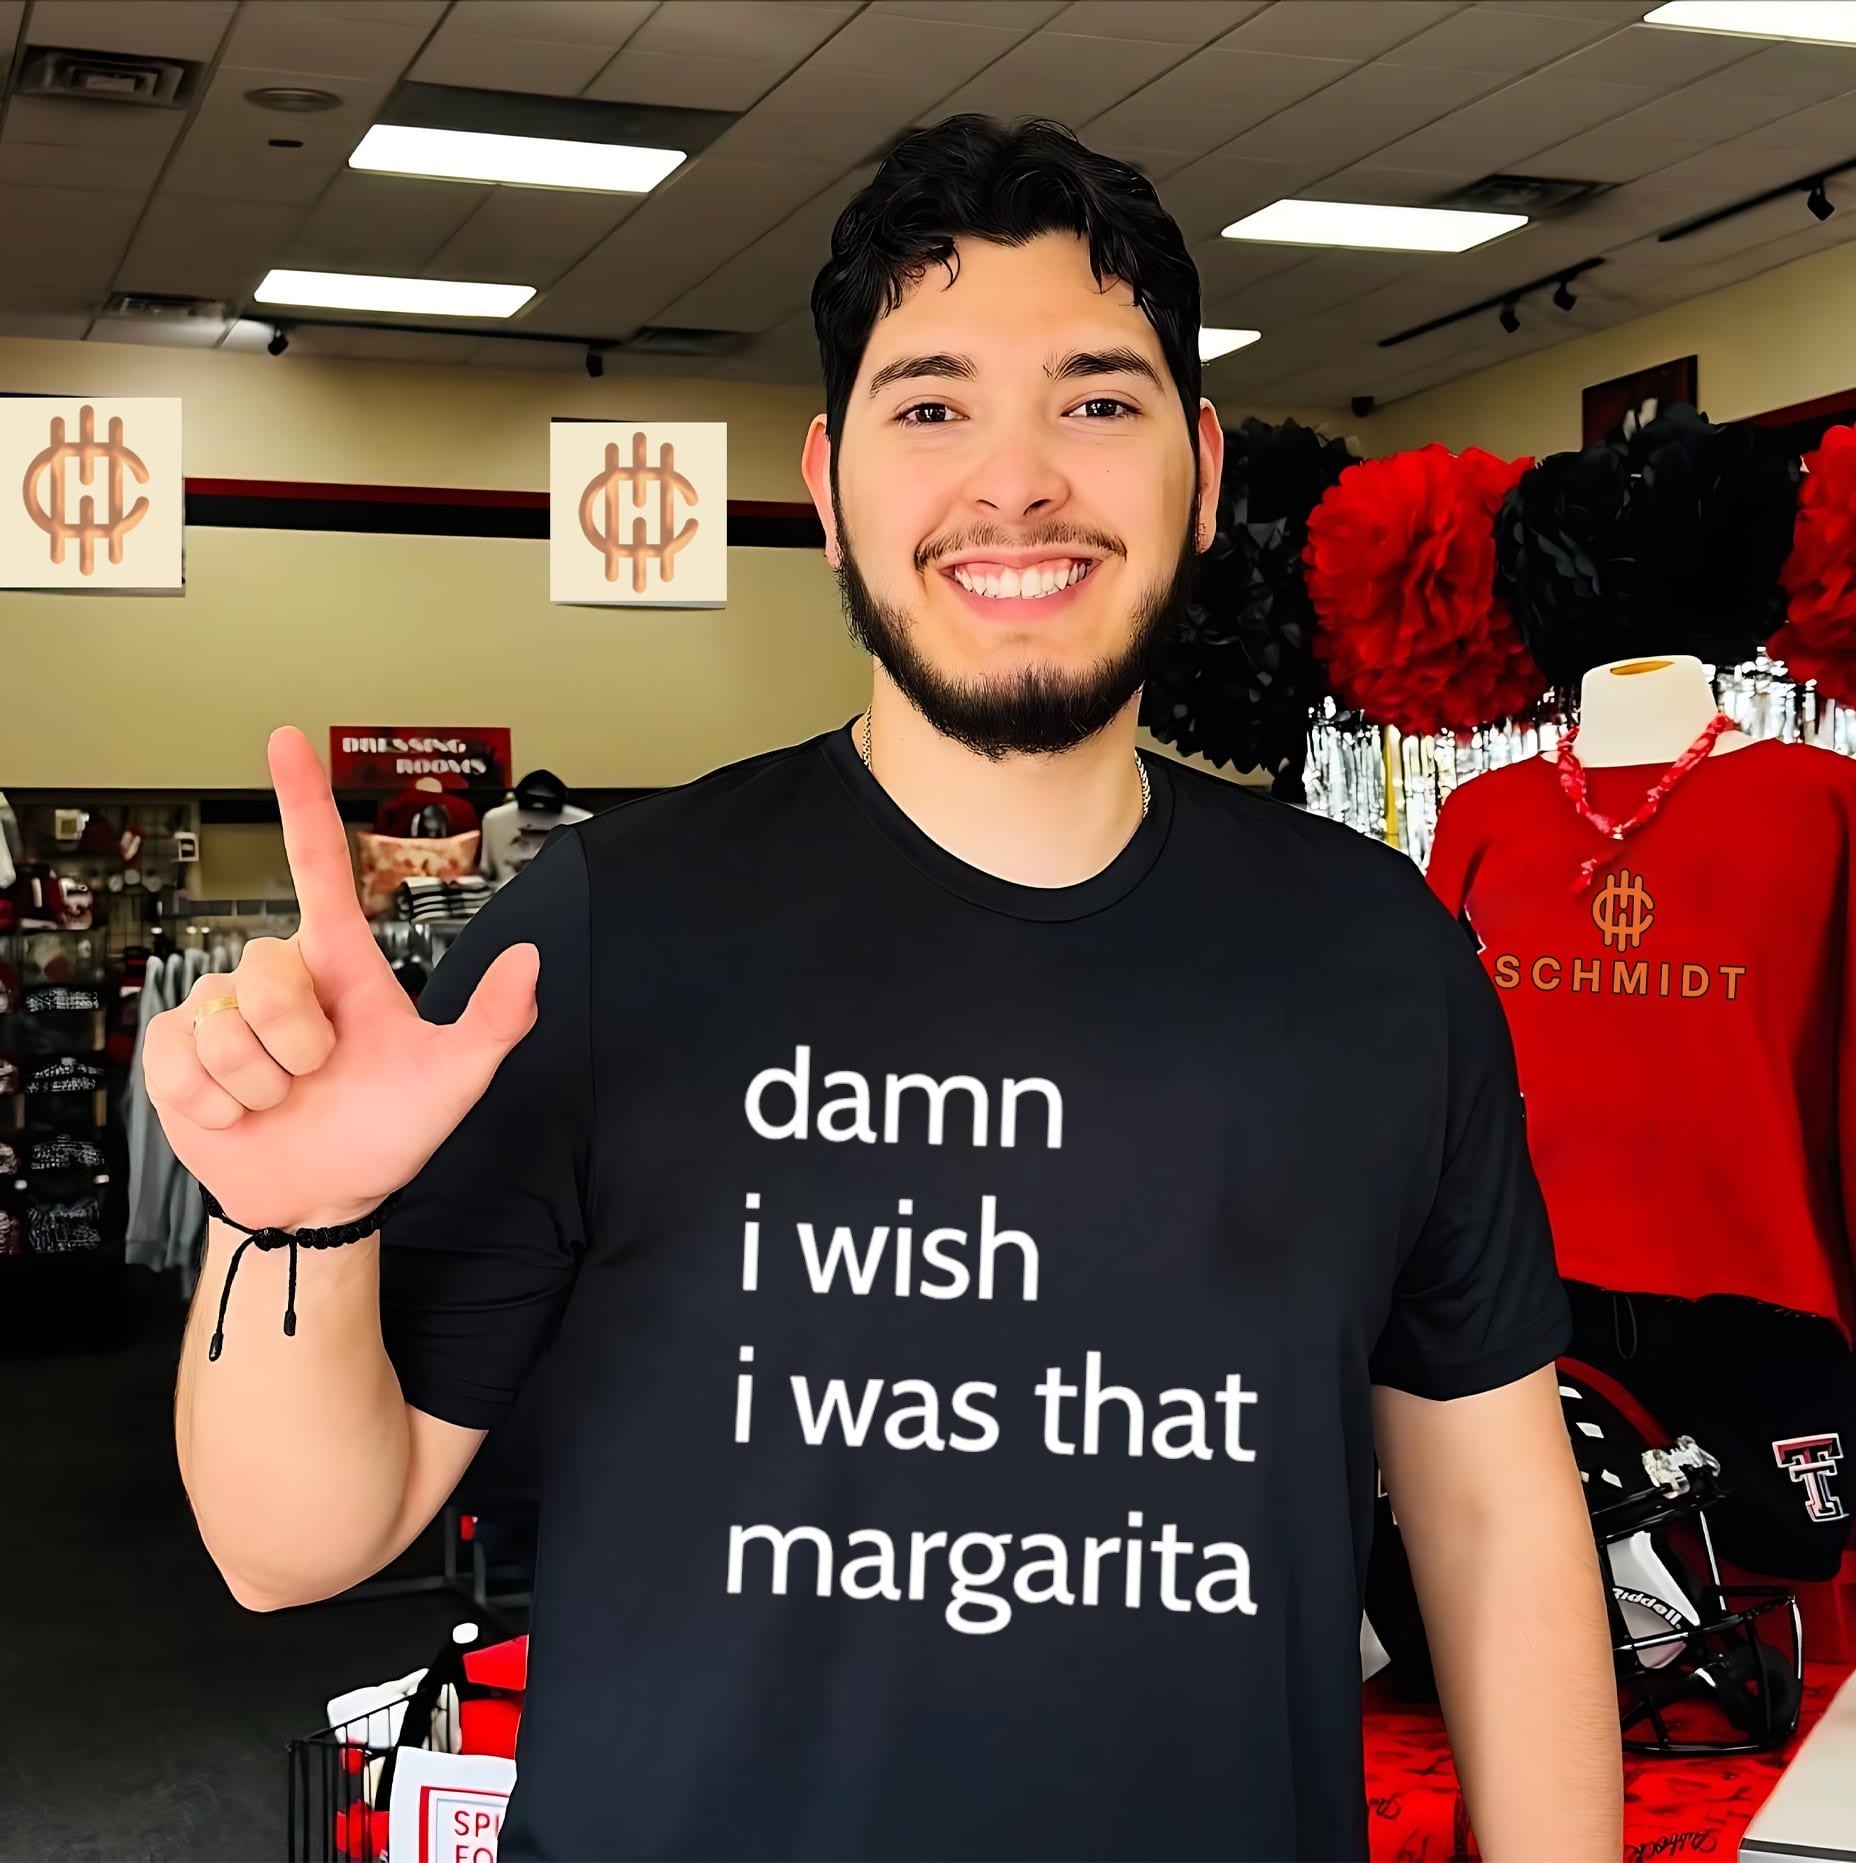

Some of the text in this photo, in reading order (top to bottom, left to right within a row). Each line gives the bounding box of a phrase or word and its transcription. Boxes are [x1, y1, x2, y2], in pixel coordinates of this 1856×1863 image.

[342, 737, 467, 753] DRESSING
[396, 758, 487, 775] ROOMS
[1493, 954, 1747, 1000] SCHMIDT
[744, 1044, 1063, 1149] damn
[742, 1192, 1039, 1301] i wish
[734, 1345, 1258, 1463] i was that
[726, 1510, 1259, 1635] margarita
